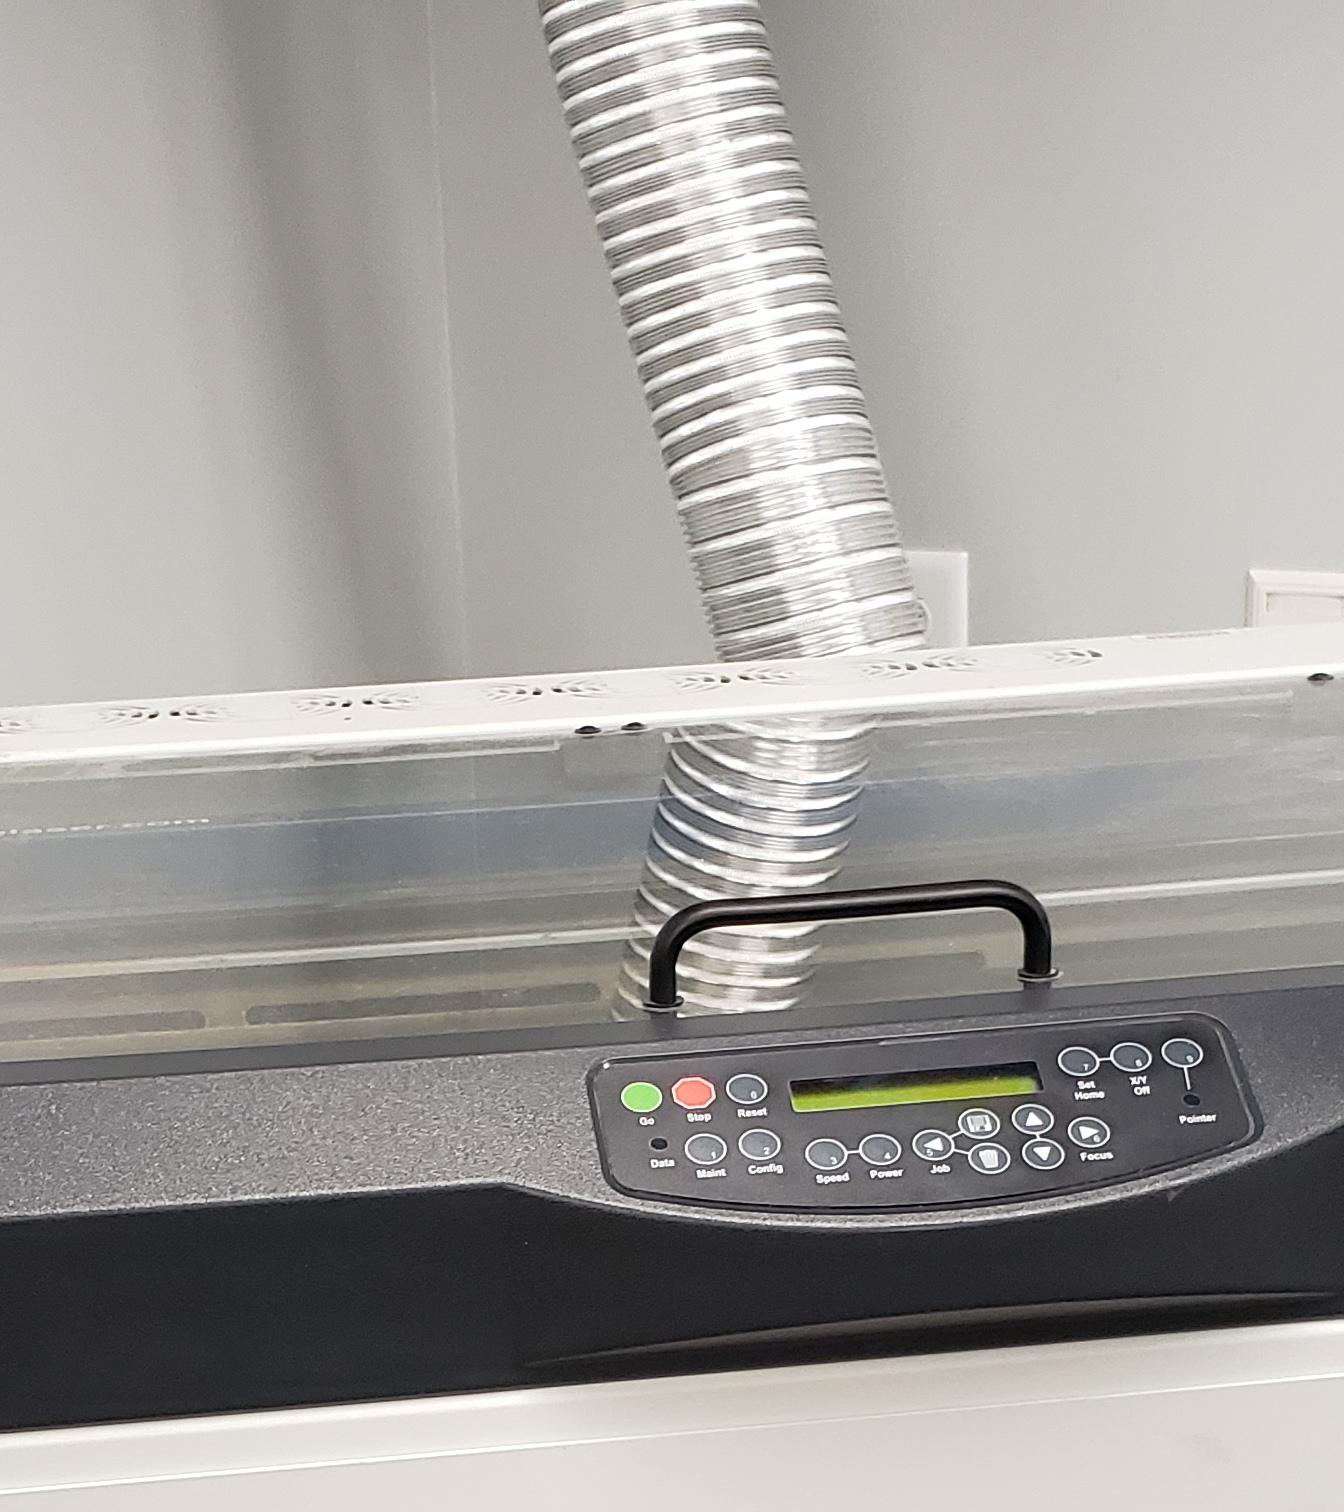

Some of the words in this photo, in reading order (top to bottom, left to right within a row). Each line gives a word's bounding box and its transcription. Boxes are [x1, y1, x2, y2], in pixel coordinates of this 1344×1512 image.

[1077, 1080, 1096, 1090] Set
[1074, 1089, 1105, 1100] Home
[686, 1113, 712, 1123] Stop
[737, 1107, 768, 1118] Reset
[639, 1117, 655, 1126] Go
[1178, 1113, 1217, 1125] Pointer
[1080, 1151, 1114, 1162] Focus
[650, 1158, 676, 1169] Data
[748, 1163, 784, 1175] Config
[696, 1168, 727, 1179] Maint
[870, 1168, 904, 1179] Power
[929, 1164, 951, 1175] Job
[816, 1172, 850, 1185] Speed
